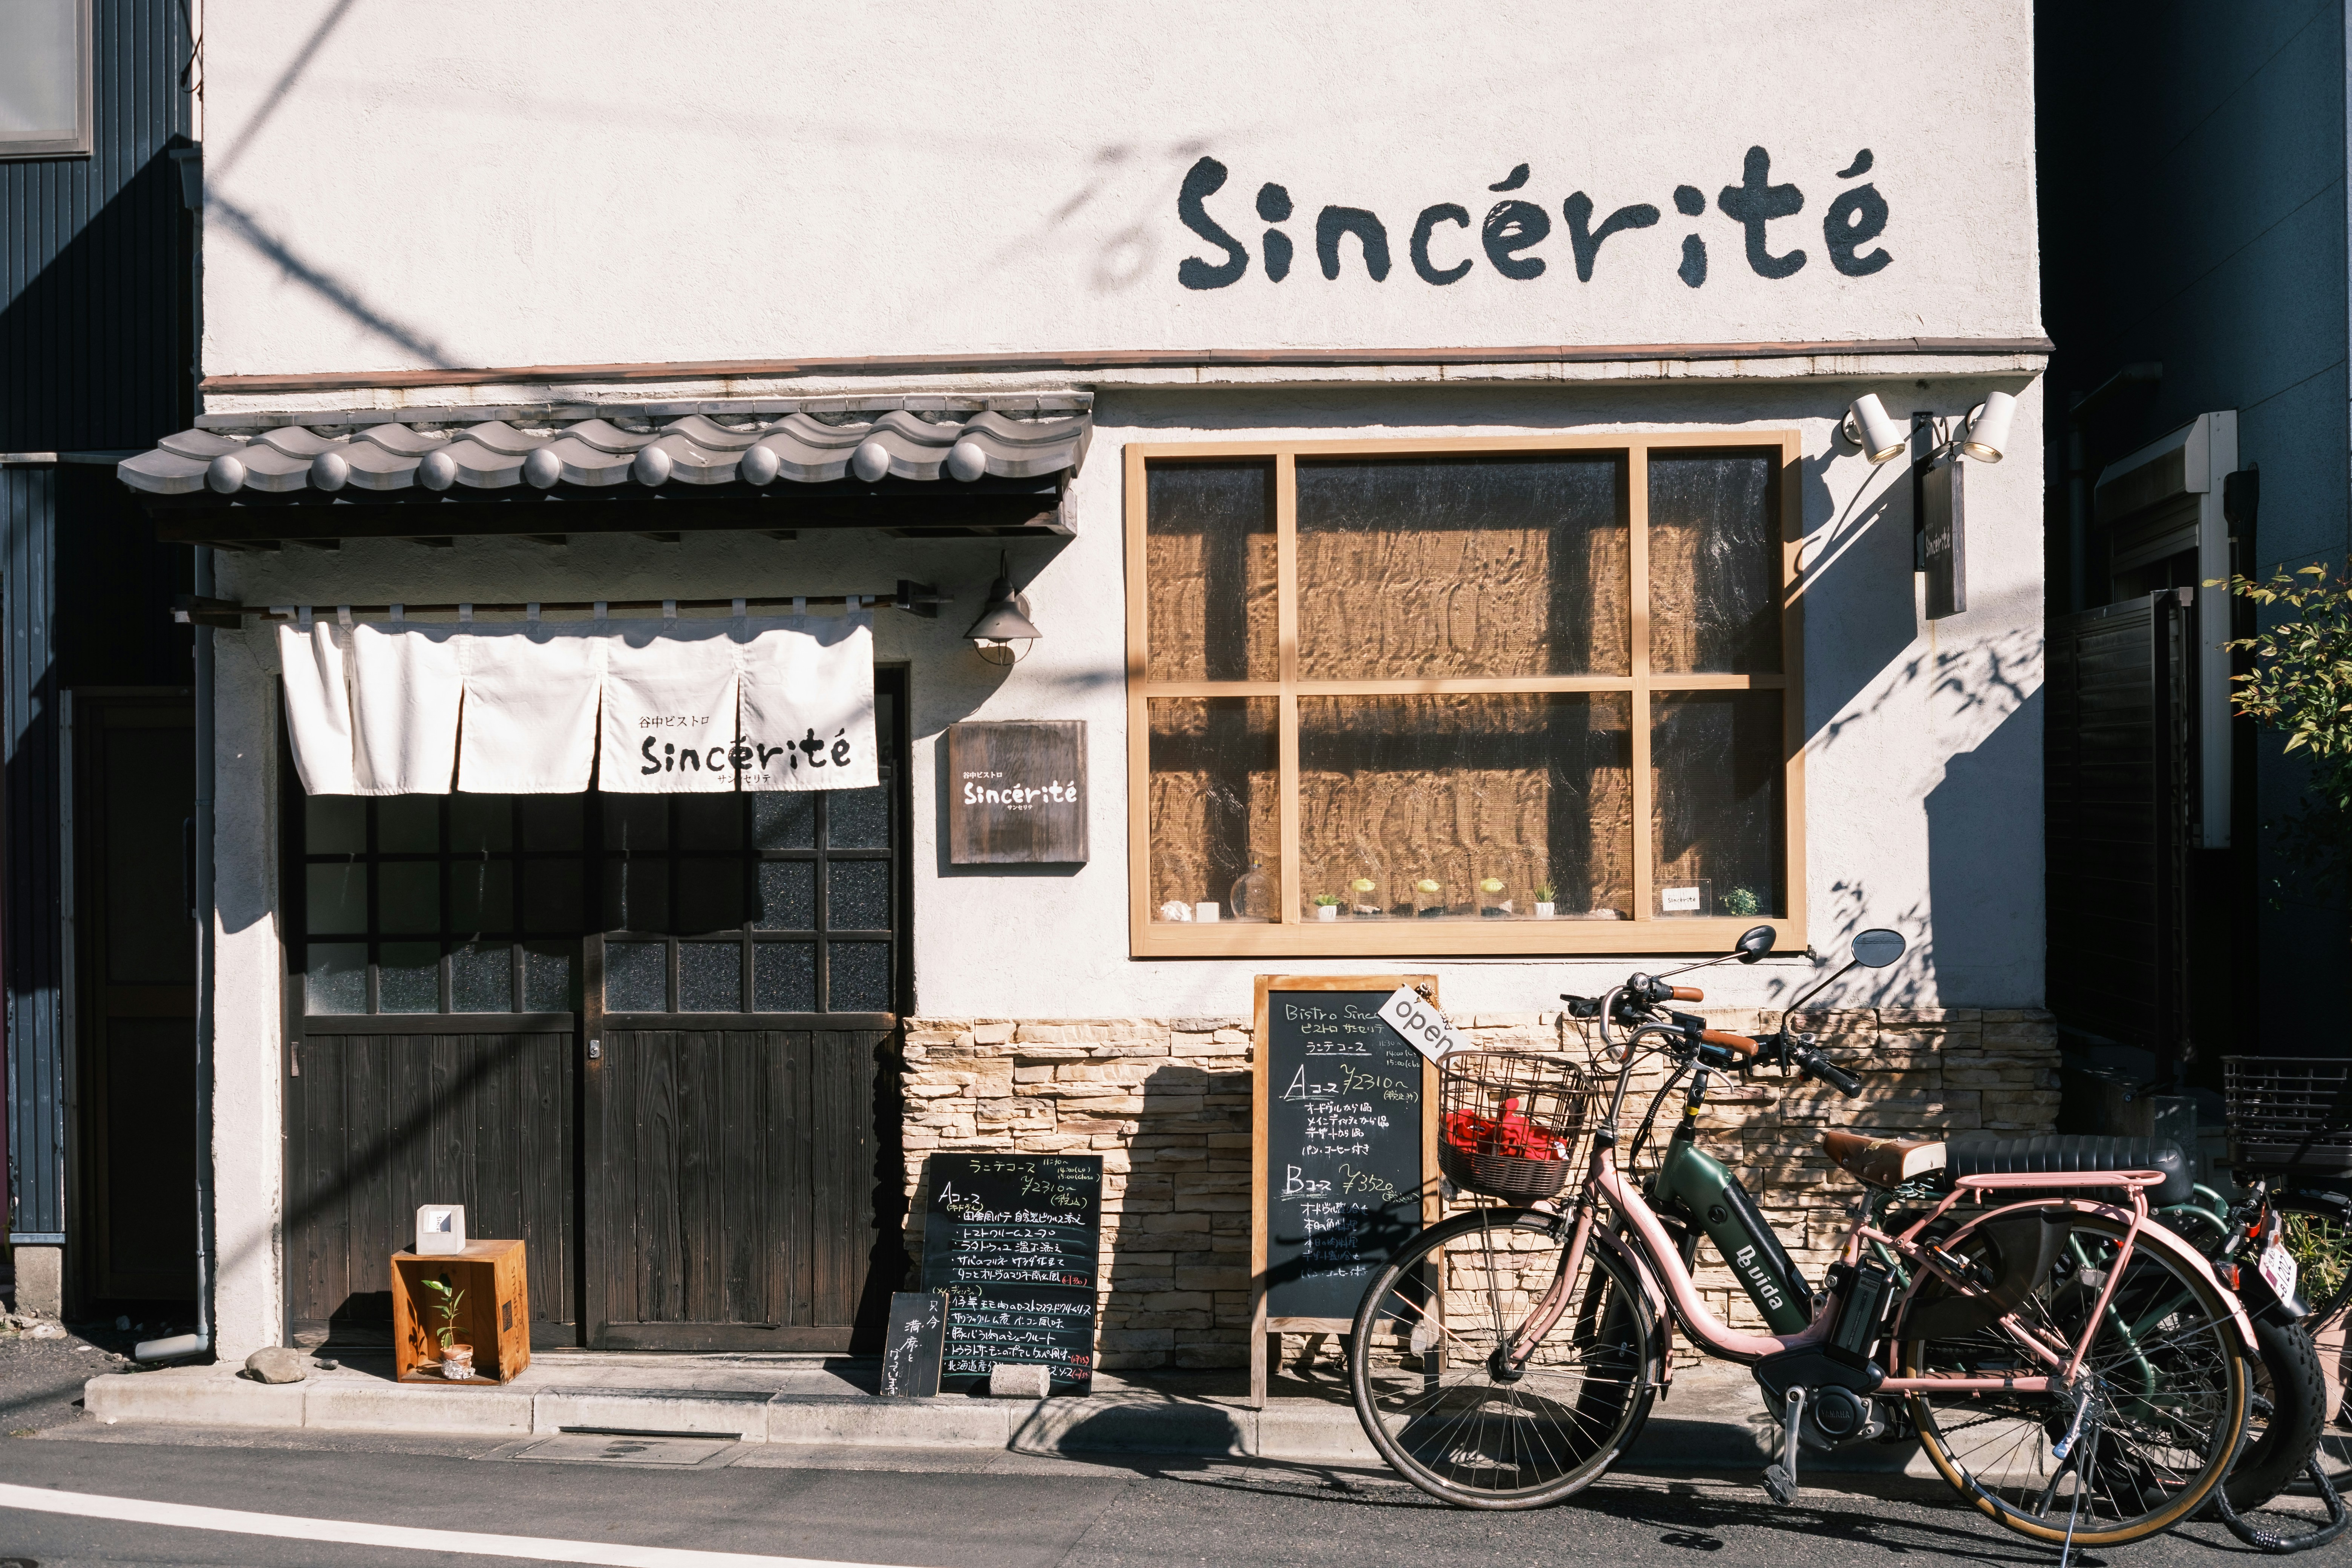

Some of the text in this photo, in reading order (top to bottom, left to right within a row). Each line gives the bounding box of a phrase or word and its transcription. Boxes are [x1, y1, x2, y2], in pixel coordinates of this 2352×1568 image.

[1178, 145, 1894, 289] Sincérité
[1926, 525, 1950, 558] Sincérité
[639, 716, 709, 728] 谷中ビストロ
[641, 728, 851, 775] Sincérité
[718, 774, 771, 784] サンセリテ
[964, 780, 1077, 805] Sincérité
[1286, 1004, 1337, 1021] Bistro
[1302, 1024, 1384, 1034] ビストロ サンセリテ
[1396, 1001, 1453, 1054] open
[926, 1300, 940, 1329] 只今
[1821, 1409, 1850, 1418] YAMAHA
